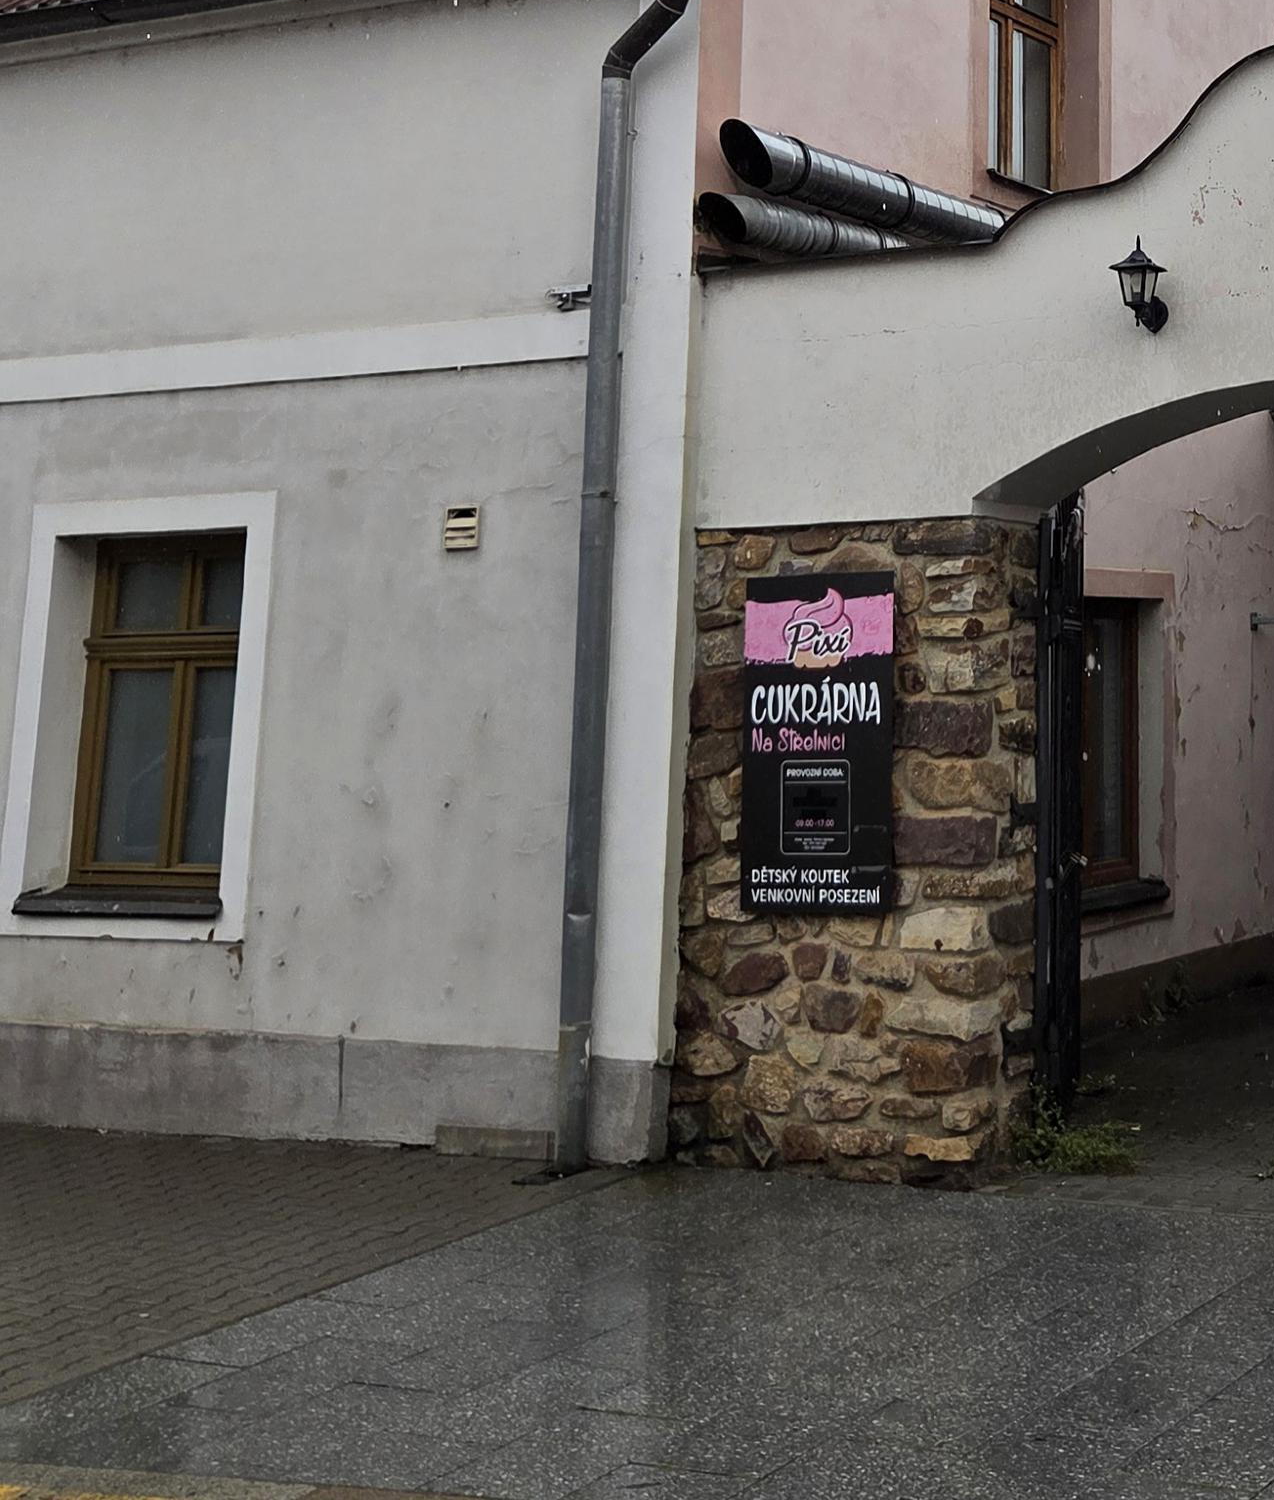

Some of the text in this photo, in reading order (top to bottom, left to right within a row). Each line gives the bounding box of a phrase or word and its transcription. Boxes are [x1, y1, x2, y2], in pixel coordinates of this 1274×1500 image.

[751, 676, 881, 726] CUKRÁRNA
[751, 728, 773, 752] Na
[786, 766, 822, 777] PROVOZNÍ
[751, 865, 850, 884] DĚTSKÝ KOUTEK
[751, 885, 880, 904] VENKOVNÍ POSEZENÍ
